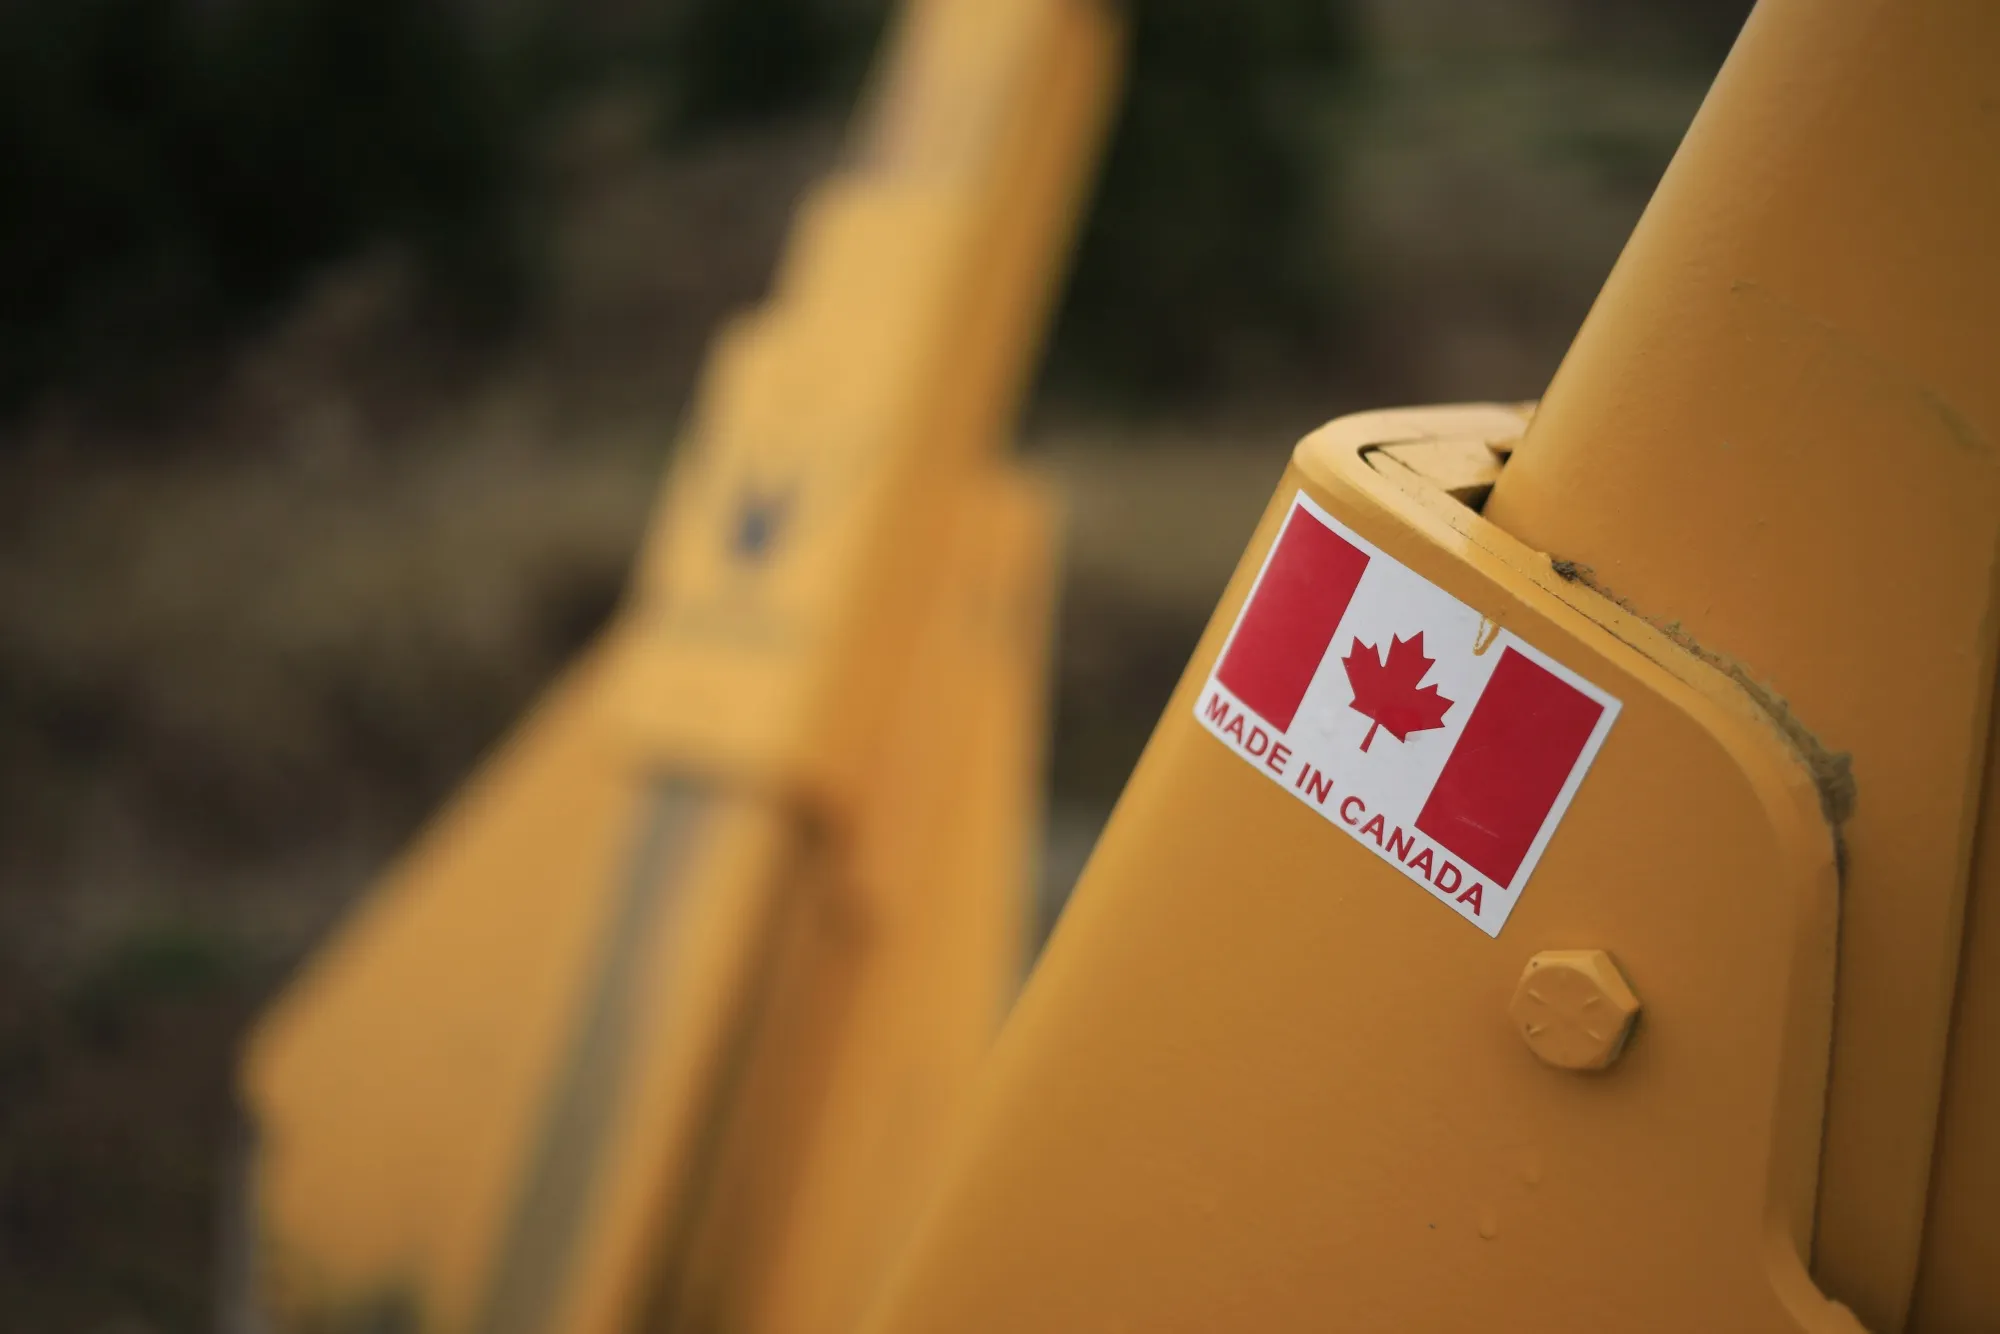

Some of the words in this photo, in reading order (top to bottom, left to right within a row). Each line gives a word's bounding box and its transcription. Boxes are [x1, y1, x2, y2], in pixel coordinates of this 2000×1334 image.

[1204, 692, 1292, 775] MADE
[1295, 763, 1334, 804] IN
[1340, 796, 1484, 917] CANADA
